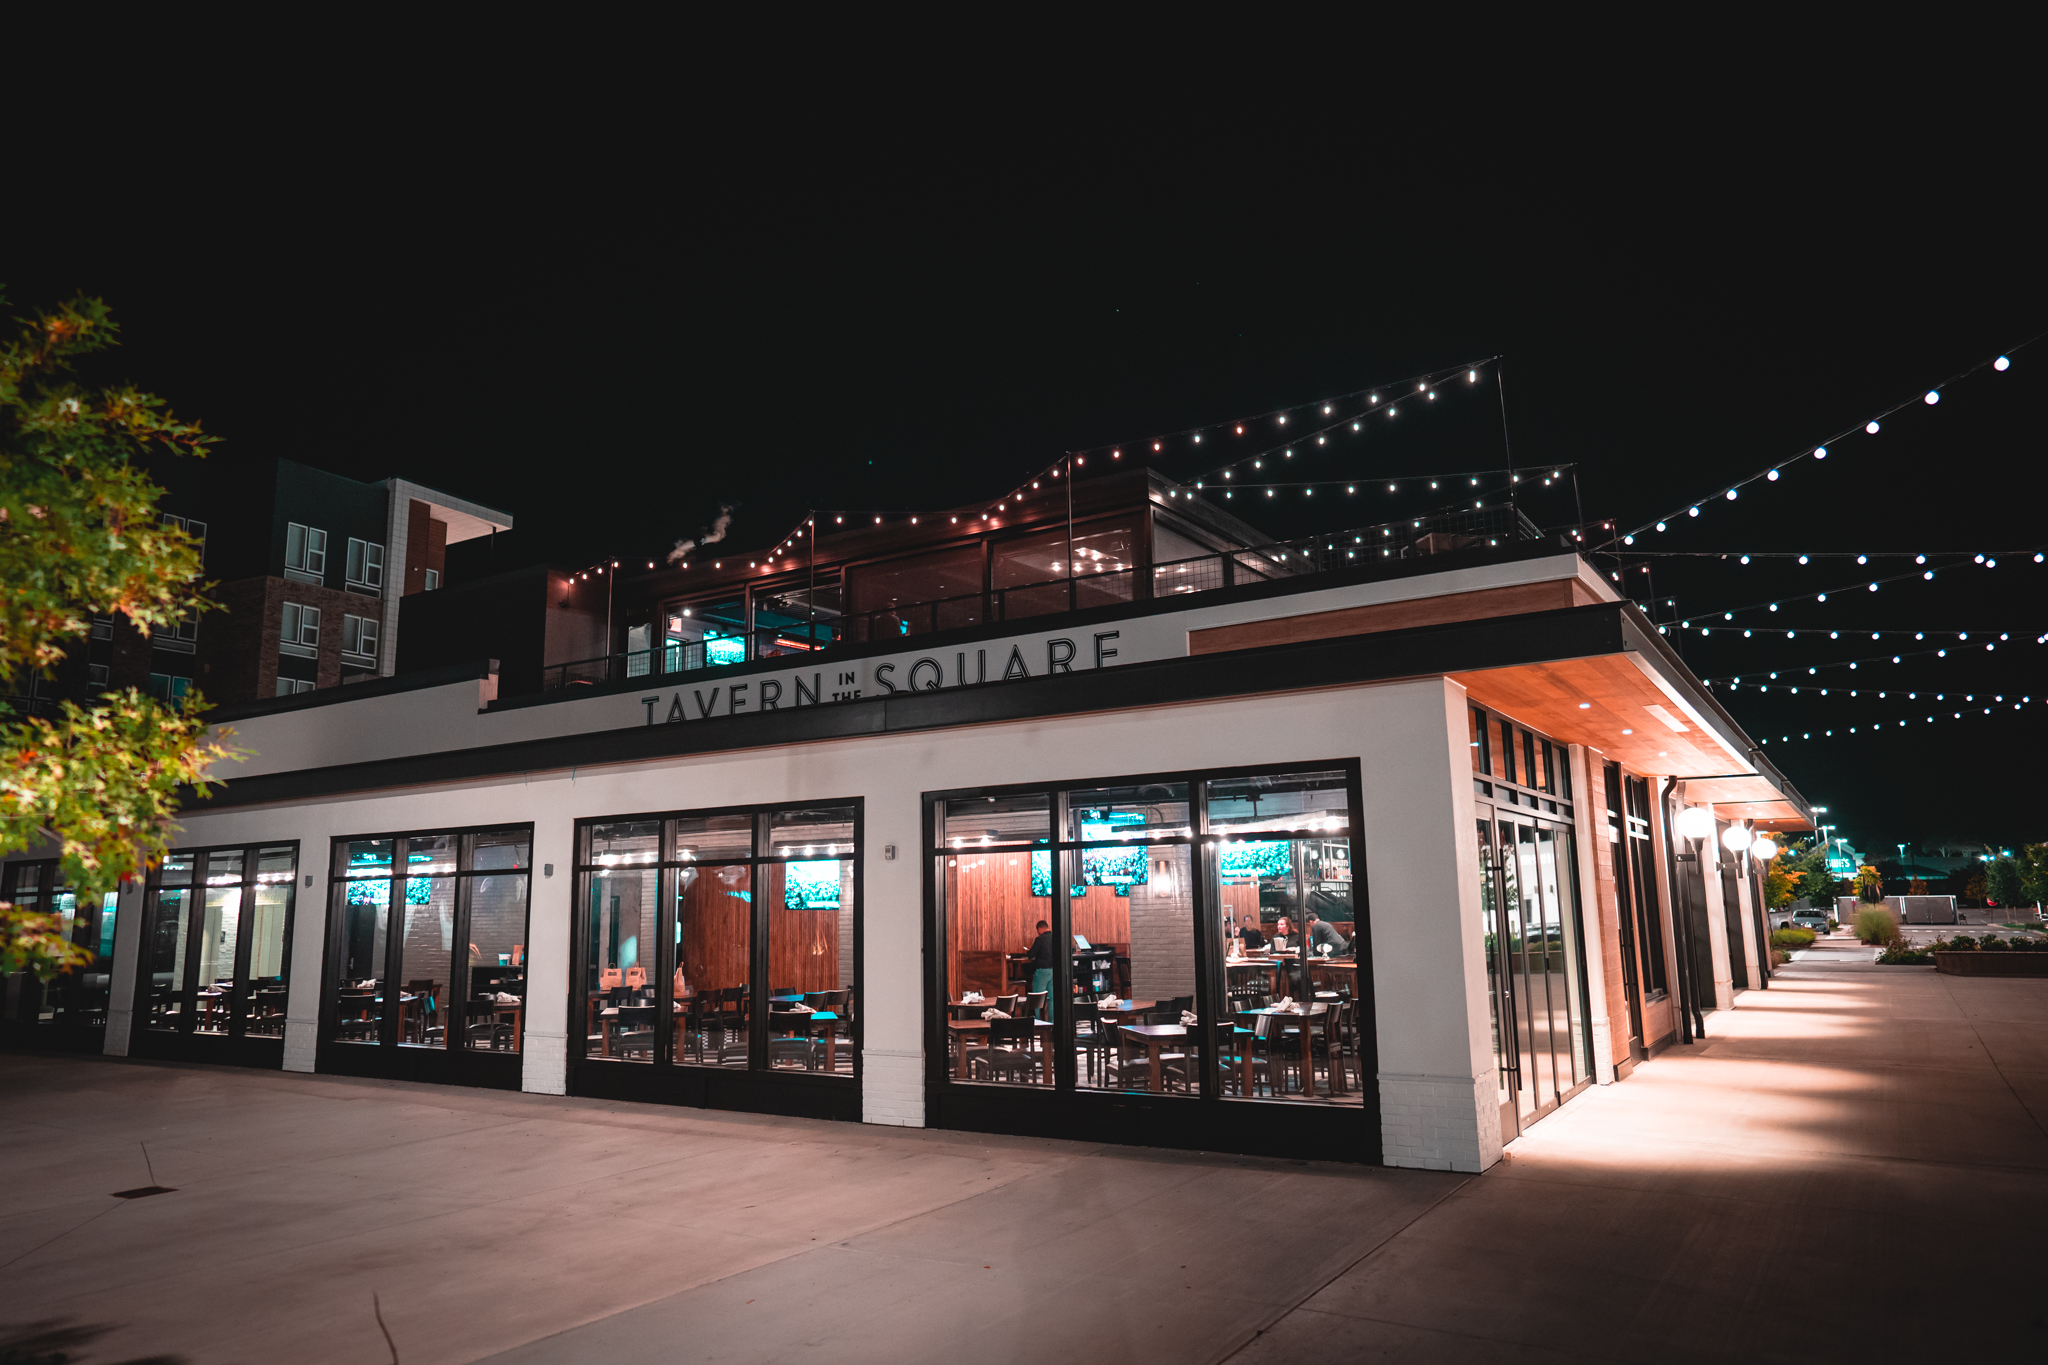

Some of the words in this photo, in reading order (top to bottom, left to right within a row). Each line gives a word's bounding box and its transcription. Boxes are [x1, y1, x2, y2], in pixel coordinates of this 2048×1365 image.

[838, 671, 855, 686] IN
[874, 630, 1120, 696] SQUARE
[641, 672, 821, 726] TAVERN
[832, 689, 861, 702] THE
